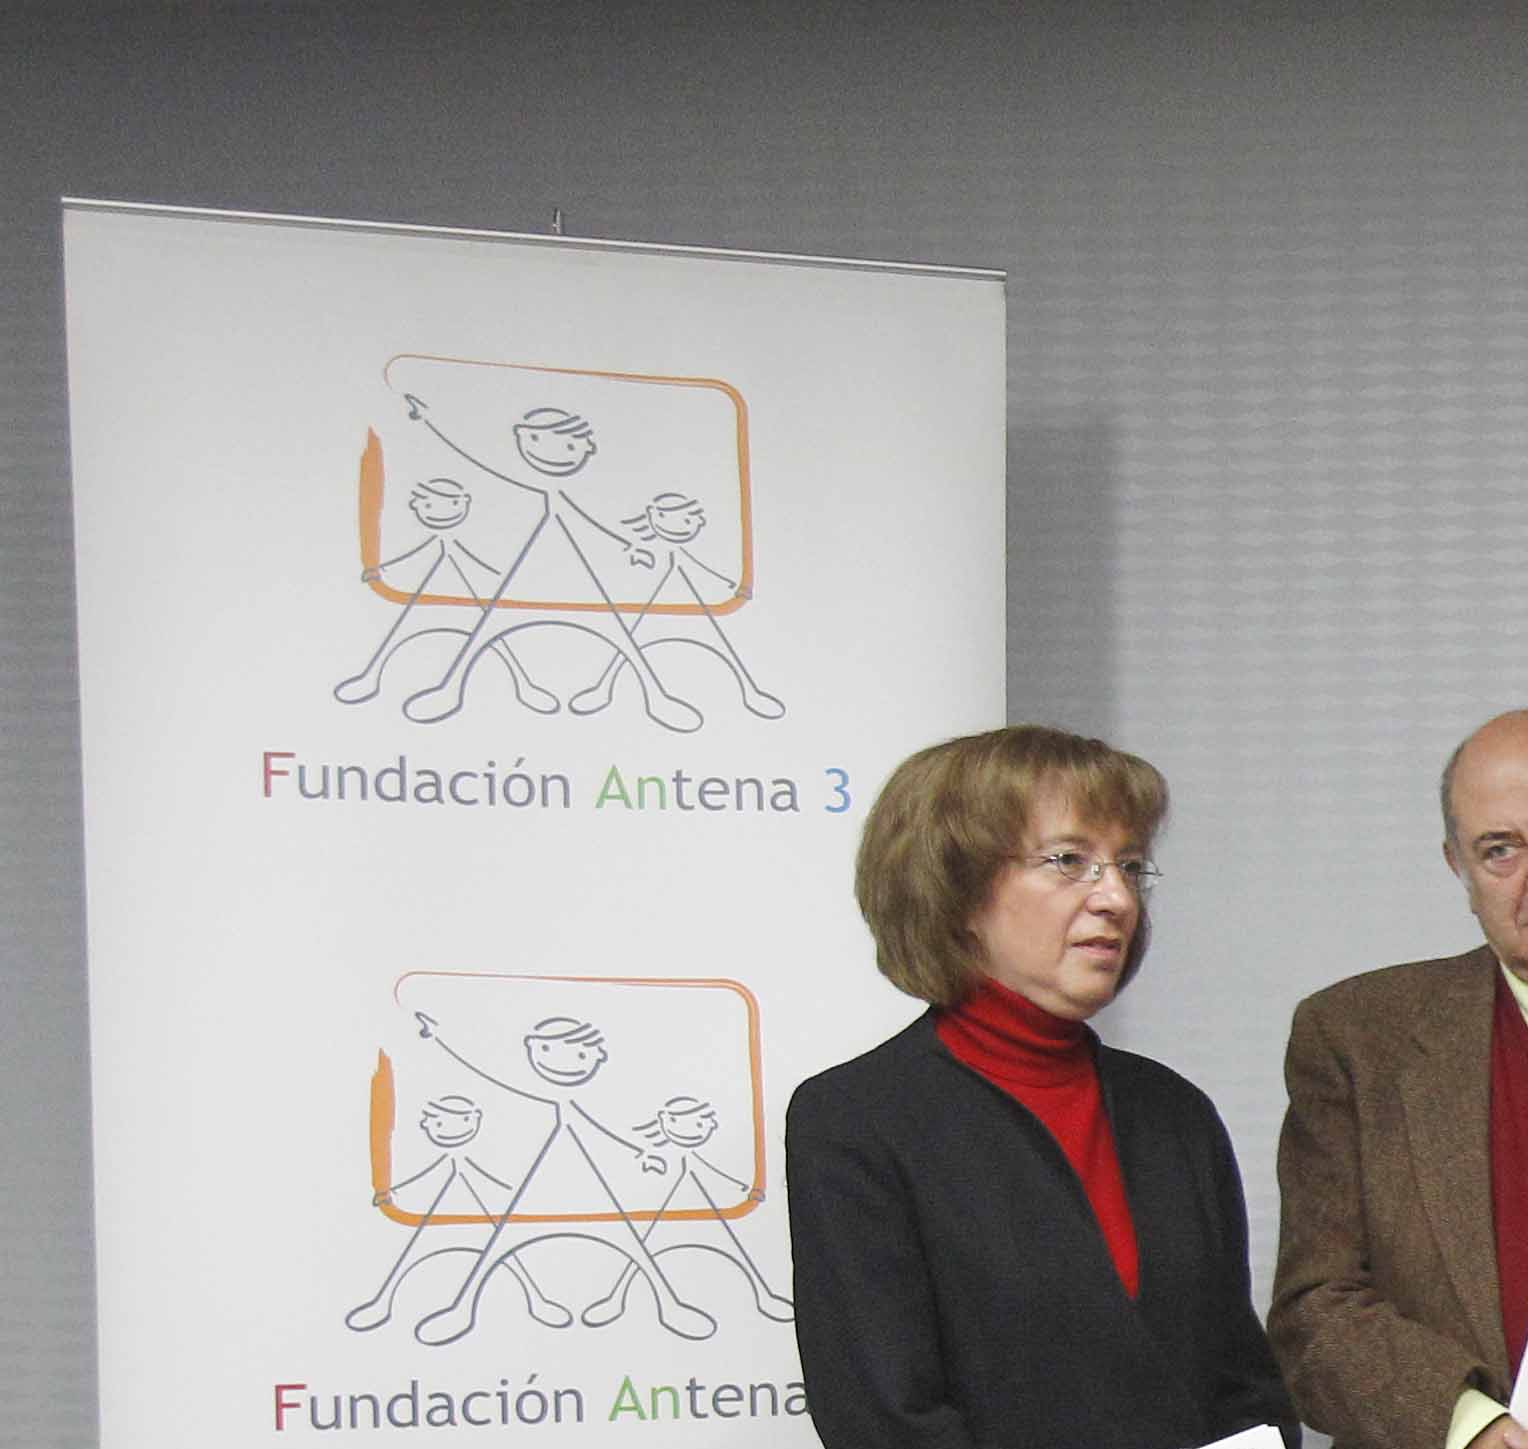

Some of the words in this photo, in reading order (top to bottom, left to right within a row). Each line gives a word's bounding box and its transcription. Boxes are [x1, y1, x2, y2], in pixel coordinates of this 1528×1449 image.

[263, 752, 570, 809] Fundación
[595, 765, 800, 812] Antena
[824, 768, 851, 813] 3
[274, 1374, 583, 1431] Fundación
[608, 1375, 808, 1421] Antena
